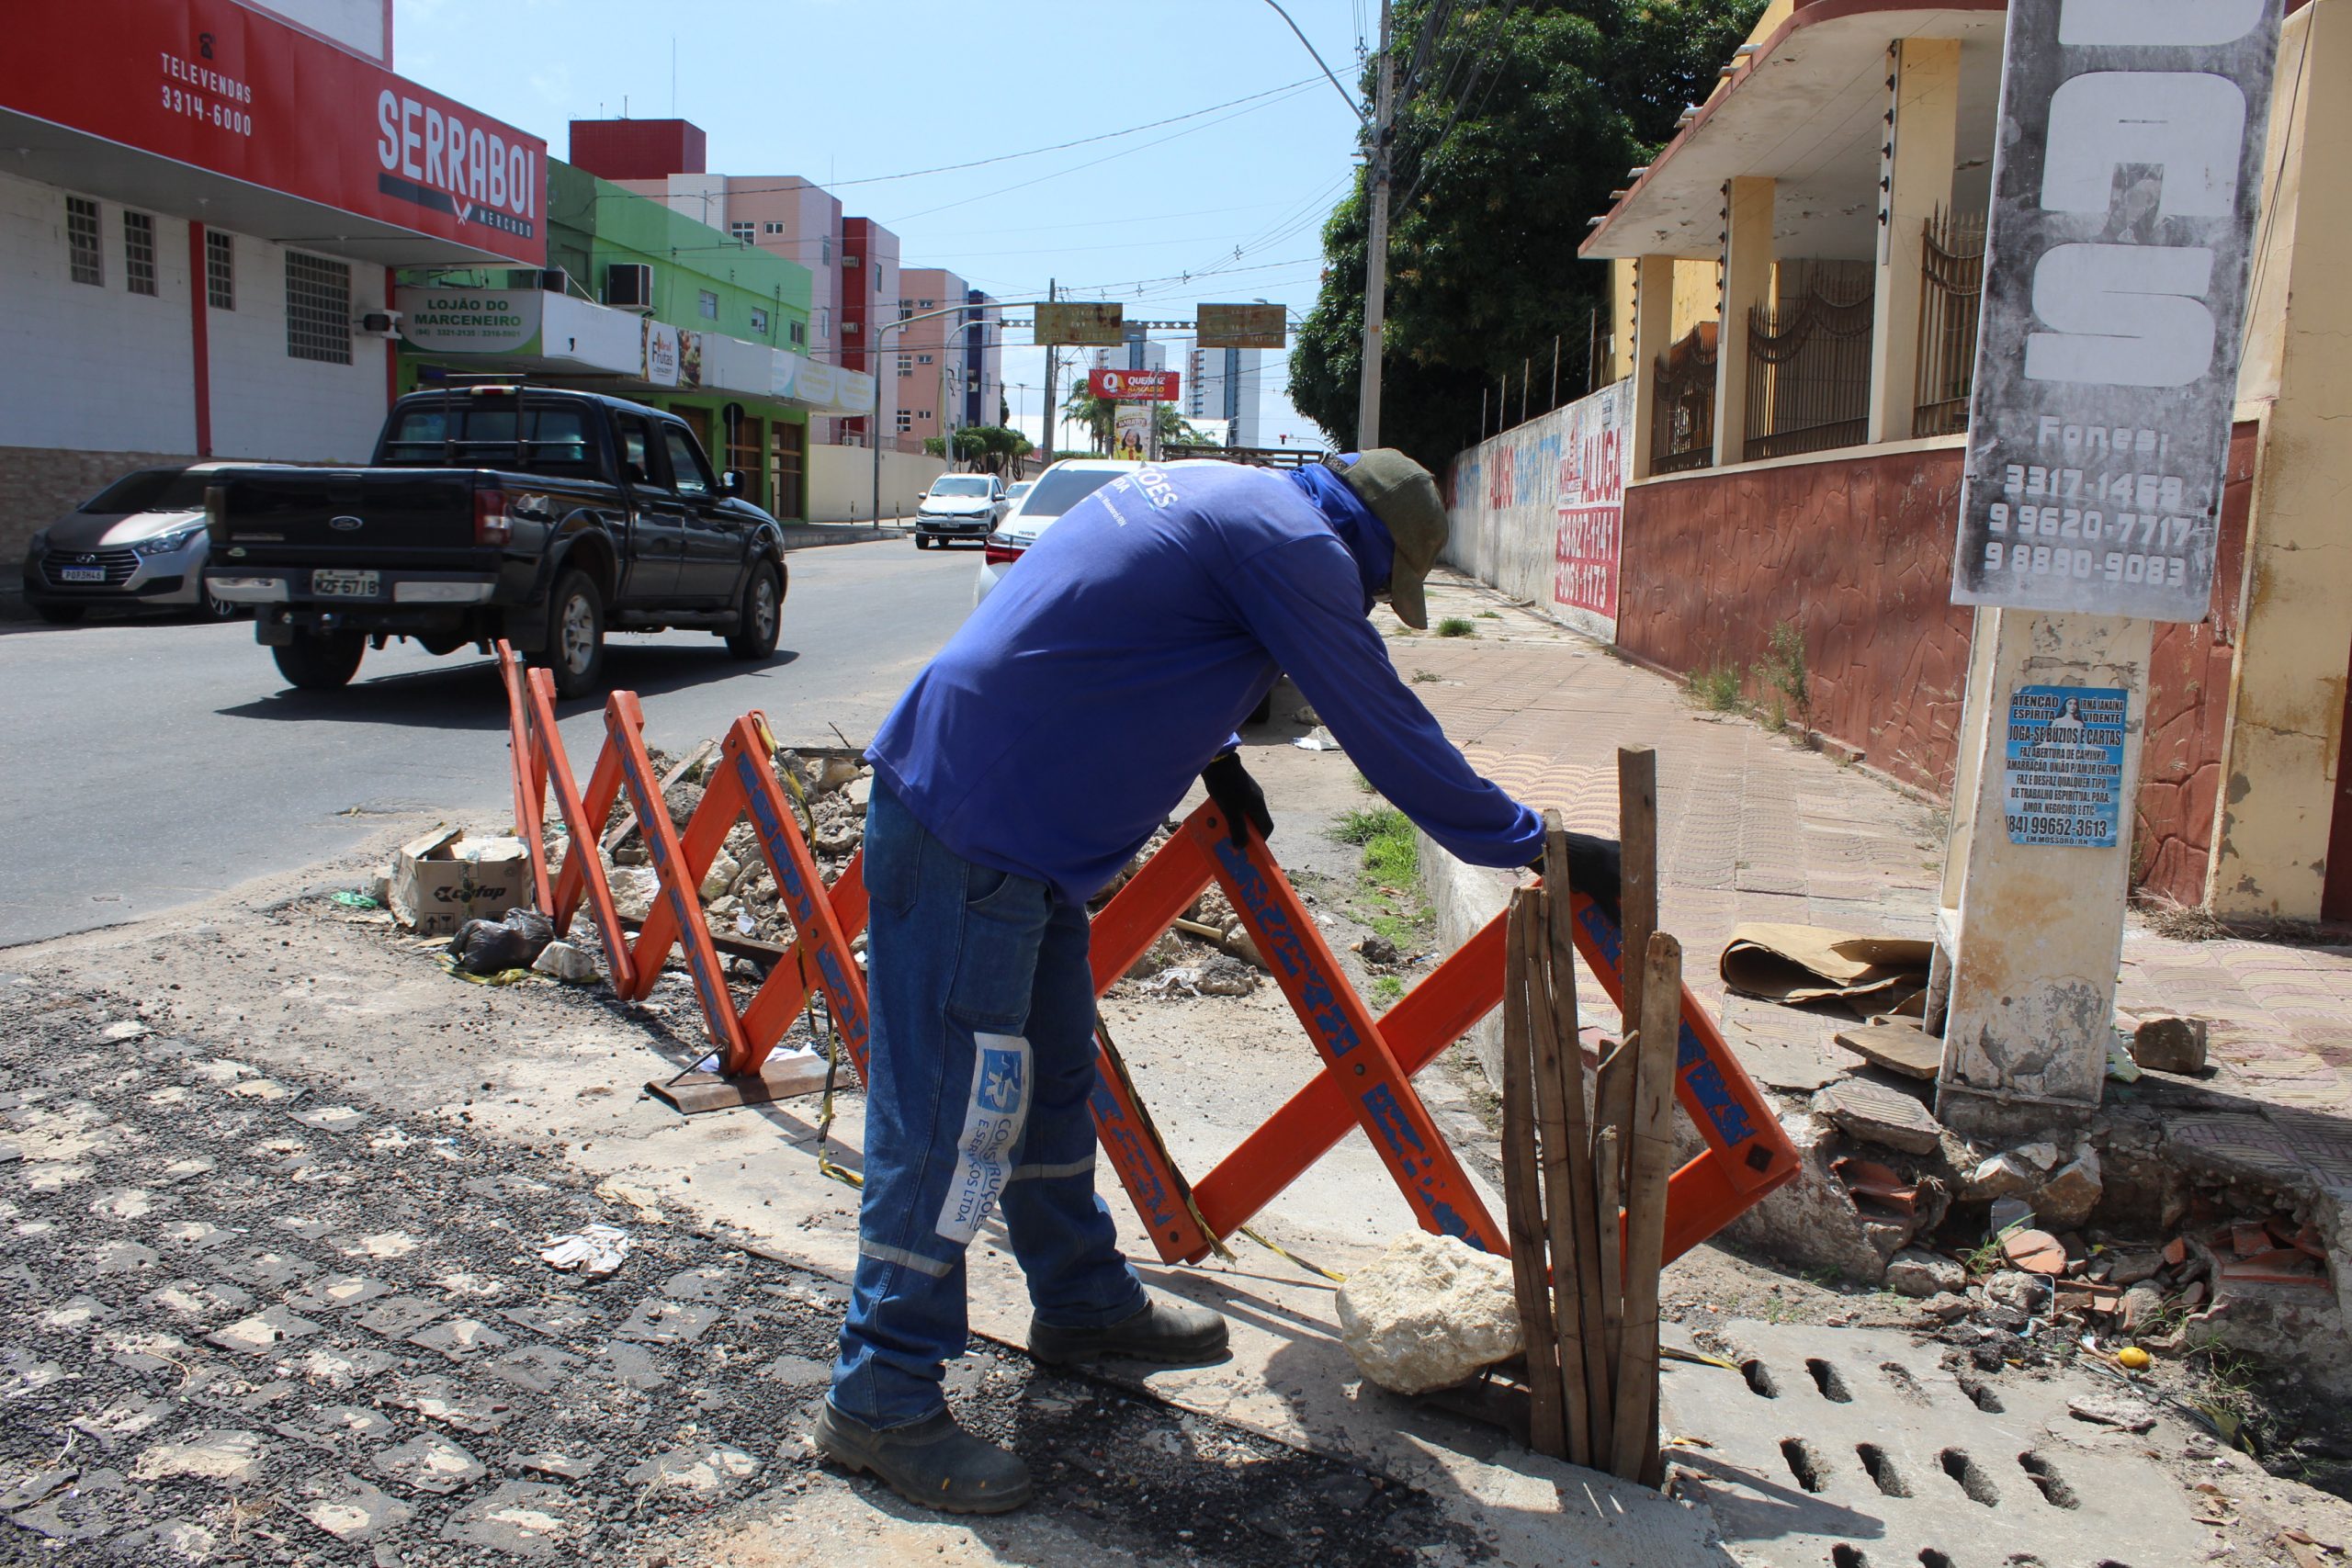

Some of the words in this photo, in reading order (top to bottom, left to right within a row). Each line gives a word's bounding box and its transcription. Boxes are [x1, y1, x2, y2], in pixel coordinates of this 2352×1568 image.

[162, 52, 251, 104] TELEVENDAS
[162, 85, 251, 137] 3314-6000
[379, 89, 535, 219] SERRABOI
[480, 209, 532, 238] MERCADO
[427, 298, 481, 310] LOJÃO
[486, 300, 509, 311] DO
[414, 314, 522, 326] MARCENEIRO
[651, 341, 673, 367] Frutas
[1580, 426, 1621, 503] ALUGA
[1561, 512, 1614, 561] 98827-1141
[1989, 502, 2009, 532] 9
[2018, 505, 2192, 550] 9620-7717
[1984, 541, 2004, 570] 9
[1559, 561, 1607, 609] 3061-1173
[2083, 712, 2121, 724] VIDENTE
[2008, 726, 2044, 741] JOGA-SE
[2045, 724, 2078, 744] BÚZIOS
[2080, 728, 2086, 744] E
[2086, 728, 2121, 746] CARTAS
[2019, 746, 2030, 757] FAZ
[2031, 747, 2065, 759] ABERTURA
[2066, 749, 2075, 760] DE
[2011, 787, 2019, 798] DE
[2020, 788, 2053, 800] TRABALHO
[2054, 790, 2090, 802] ESPIRITUAL
[2017, 774, 2028, 784] FAZ
[2029, 775, 2033, 785] E
[2033, 775, 2056, 786] DESFAZ
[2057, 777, 2090, 788] QUALQUER
[2091, 778, 2107, 789] TIPO
[2077, 805, 2082, 816] E
[2006, 816, 2029, 833] (84)
[2031, 817, 2108, 838] 99652-3613
[978, 1119, 989, 1129] E
[955, 1190, 975, 1224] LTDA
